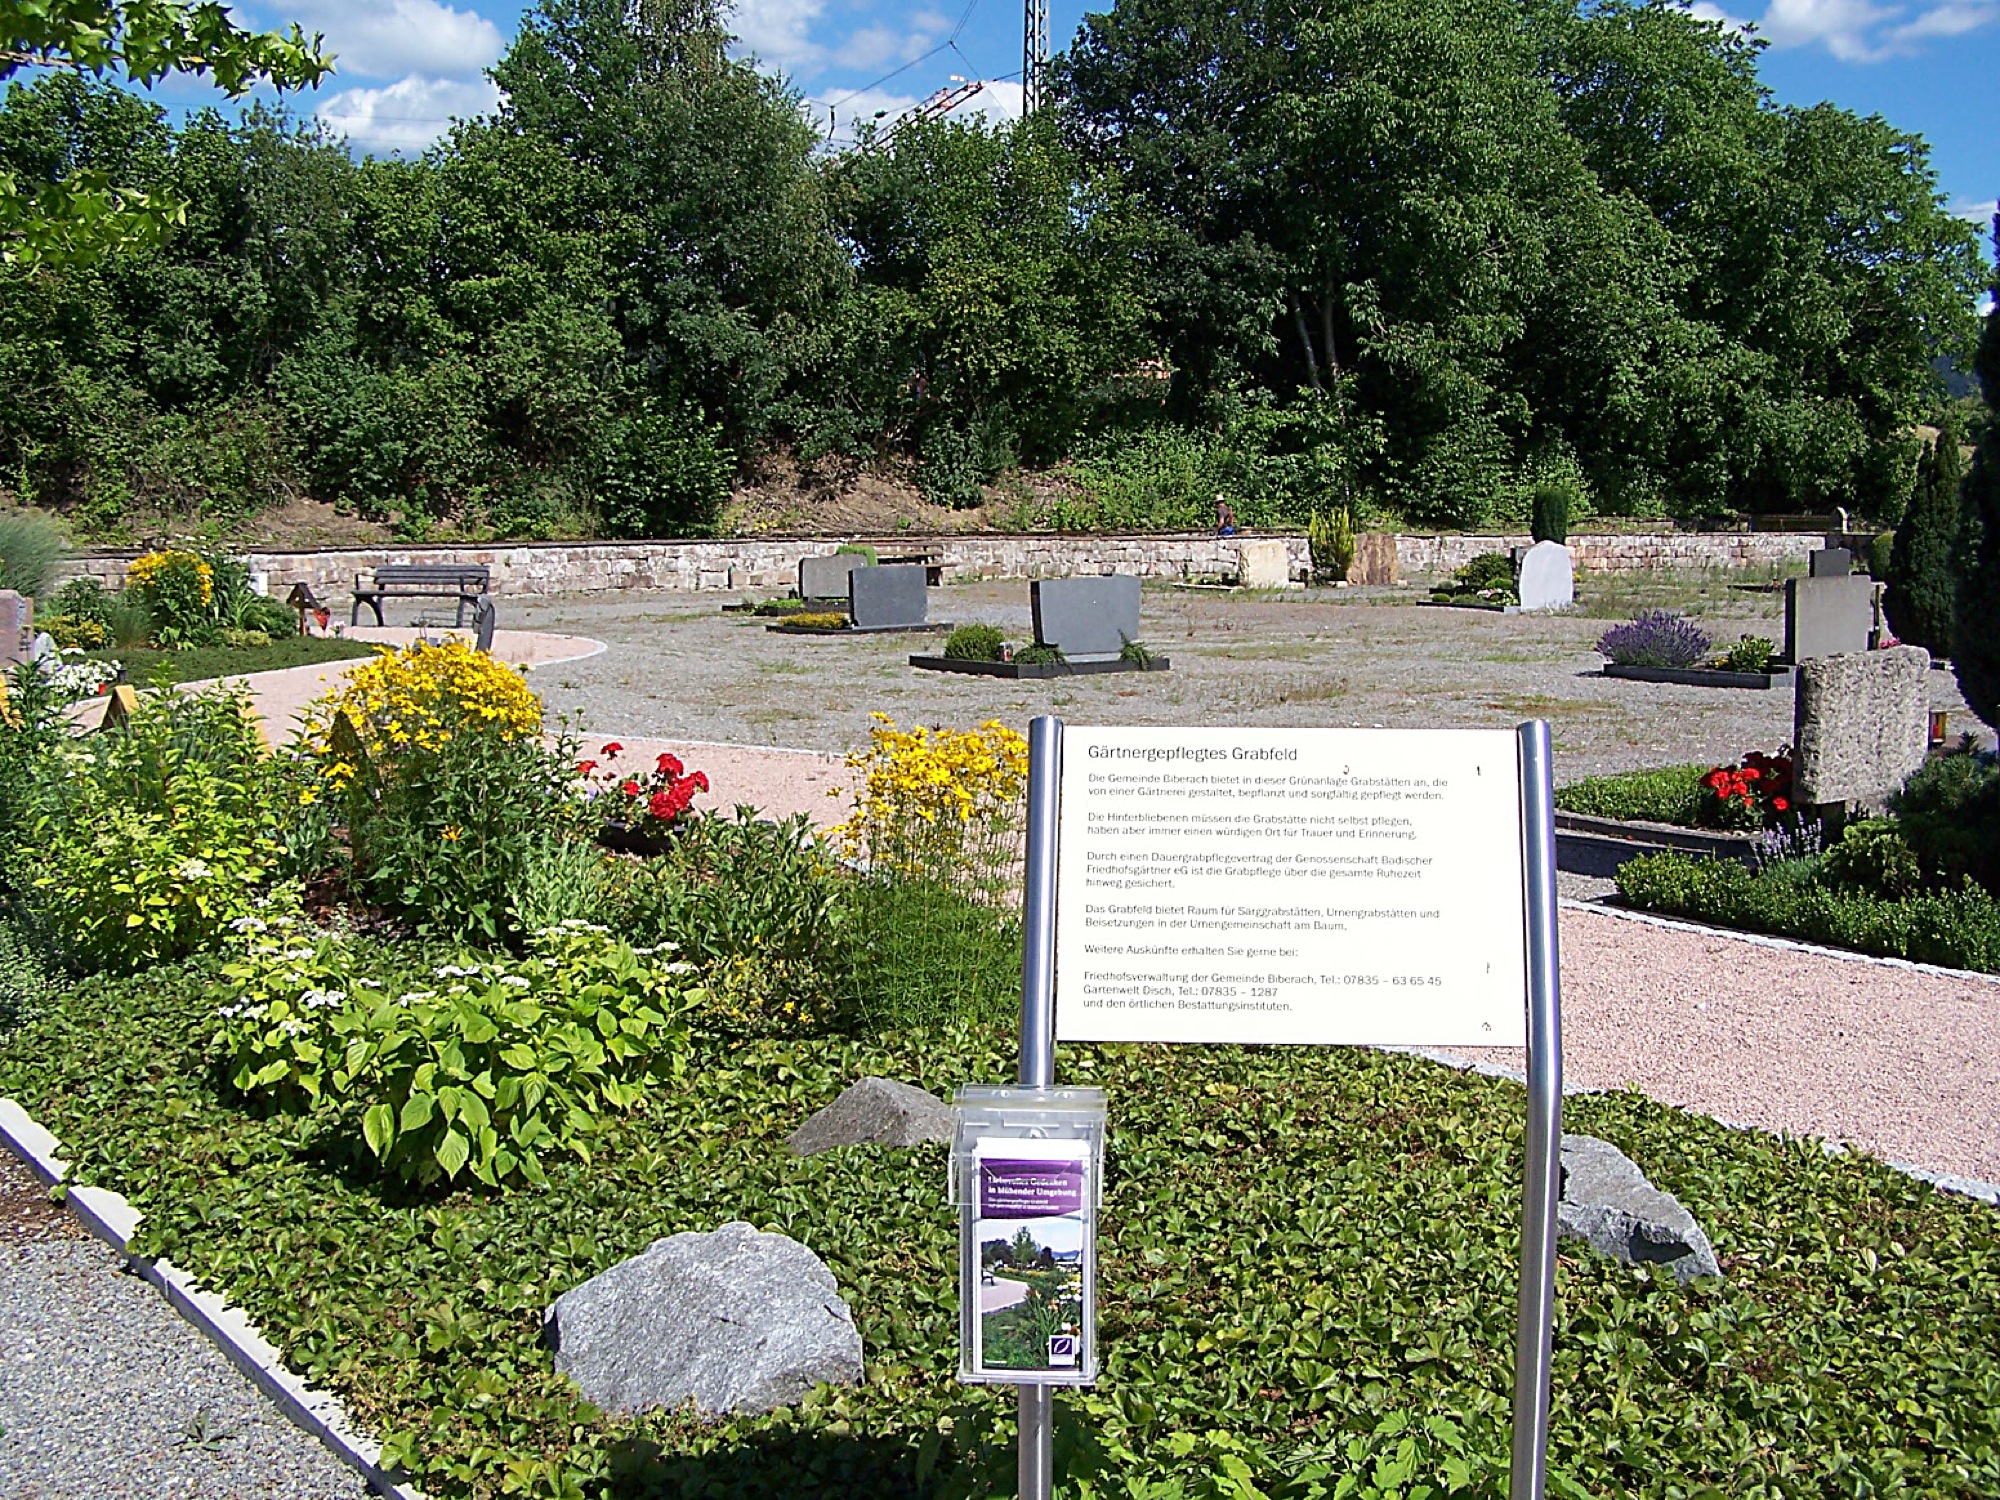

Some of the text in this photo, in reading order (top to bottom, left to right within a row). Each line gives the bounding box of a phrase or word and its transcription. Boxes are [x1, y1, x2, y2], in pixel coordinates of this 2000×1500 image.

[1088, 745, 1297, 762] Gärtnergepflegtes Grabfeld
[1088, 772, 1105, 782] Die
[1107, 773, 1160, 783] Gemeinde
[1162, 774, 1208, 783] Biberach
[1210, 775, 1239, 784] bietet
[1242, 775, 1252, 784] in
[1254, 776, 1286, 785] dieser
[1288, 776, 1348, 787] Grünanlage
[1349, 776, 1411, 786] Grabstätten
[1432, 777, 1448, 787] die
[1108, 788, 1135, 796] einer
[1137, 786, 1186, 796] Gärtnerei
[1237, 788, 1285, 798] bepflanzt
[1288, 789, 1308, 798] und
[1310, 789, 1358, 800] sorgfältig
[1360, 790, 1401, 801] gepflegt
[1088, 811, 1104, 821] Die
[1107, 812, 1189, 822] Hinterbliebenen
[1191, 815, 1231, 823] müssen
[1233, 815, 1250, 823] die
[1253, 814, 1307, 824] Grabstätte
[1309, 815, 1335, 824] nicht
[1337, 815, 1368, 825] selbst
[1087, 825, 1119, 834] haben
[1121, 826, 1145, 835] aber
[1148, 826, 1181, 835] immer
[1215, 826, 1262, 838] würdigen
[1264, 827, 1280, 837] Ort
[1283, 828, 1297, 837] für
[1301, 828, 1333, 837] Trauer
[1335, 829, 1355, 838] und
[1086, 851, 1432, 865] Durch einen Dauergrabpflegevertrag der Genossenschaft Badischer
[1086, 864, 1421, 879] Friedhofsgärtner eG ist die Grabpflege über die gesamte Ruhezeit
[1085, 878, 1122, 888] hinweg
[1085, 904, 1105, 913] Das
[1107, 904, 1152, 914] Grabfeld
[1155, 905, 1184, 915] bietet
[1187, 905, 1218, 915] Raum
[1220, 905, 1235, 916] für
[1326, 908, 1417, 920] Urnengrabstätten
[1419, 909, 1440, 918] und
[1085, 917, 1154, 929] Beisetzungen
[1157, 918, 1167, 927] in
[1169, 919, 1187, 928] der
[1189, 919, 1291, 931] Urnengemeinschaft
[1293, 922, 1310, 930] am
[1084, 944, 1124, 954] Weitere
[1125, 945, 1178, 955] Auskünfte
[1180, 946, 1224, 955] erhalten
[1227, 946, 1244, 955] Sie
[1246, 948, 1276, 958] gerne
[1083, 971, 1189, 983] Friedhofsverwaltung
[1191, 972, 1208, 982] der
[1210, 972, 1265, 983] Gemeinde
[1343, 975, 1379, 985] 07835
[1392, 976, 1407, 985] 63
[1409, 976, 1424, 986] 65
[1427, 976, 1442, 986] 45
[1083, 984, 1139, 995] Gartenwelt
[1200, 986, 1237, 996] 07835
[1250, 987, 1278, 997] 1287
[1083, 998, 1103, 1008] und
[1105, 998, 1126, 1008] den
[1128, 999, 1175, 1009] örtlichen
